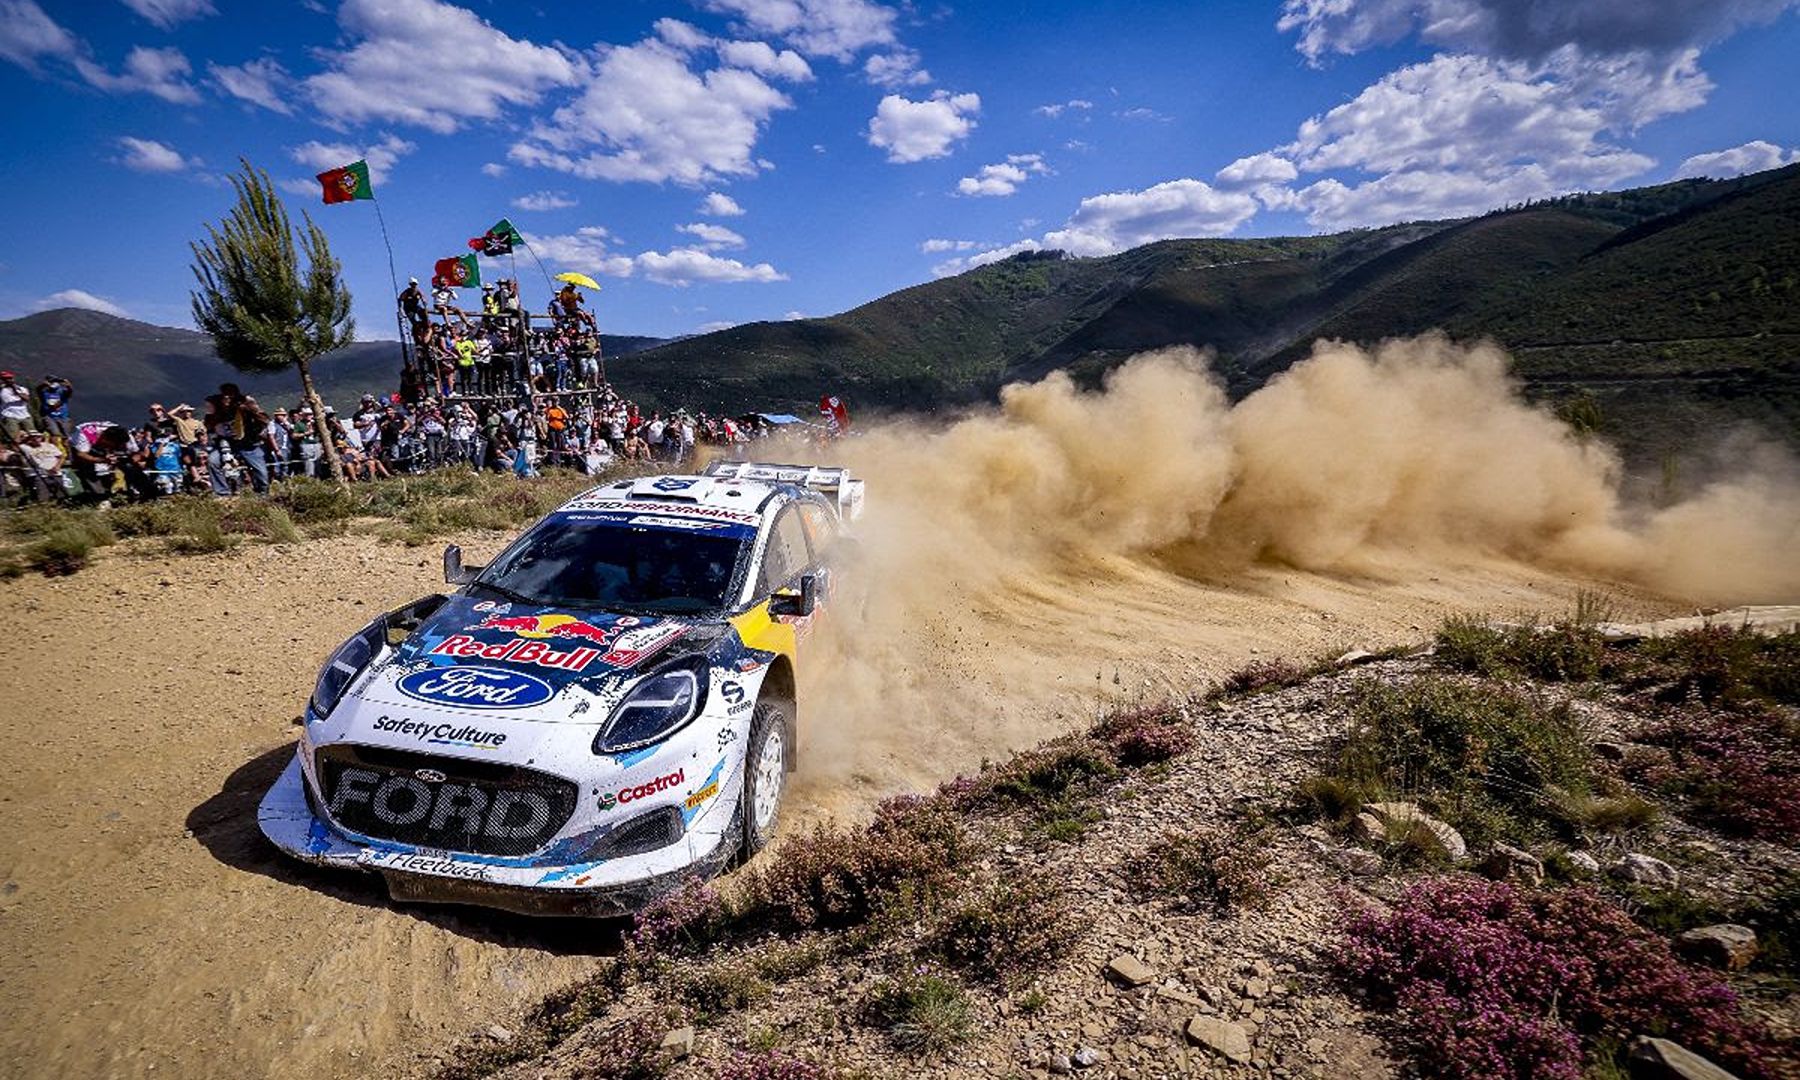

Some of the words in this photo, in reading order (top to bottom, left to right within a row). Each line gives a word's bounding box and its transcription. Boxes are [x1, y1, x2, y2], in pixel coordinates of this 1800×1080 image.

[429, 634, 523, 659] Red
[511, 639, 601, 672] Bull
[418, 669, 531, 702] Ford
[373, 715, 507, 745] SafetyCulture
[328, 767, 551, 838] FORD
[617, 768, 685, 803] Castrol
